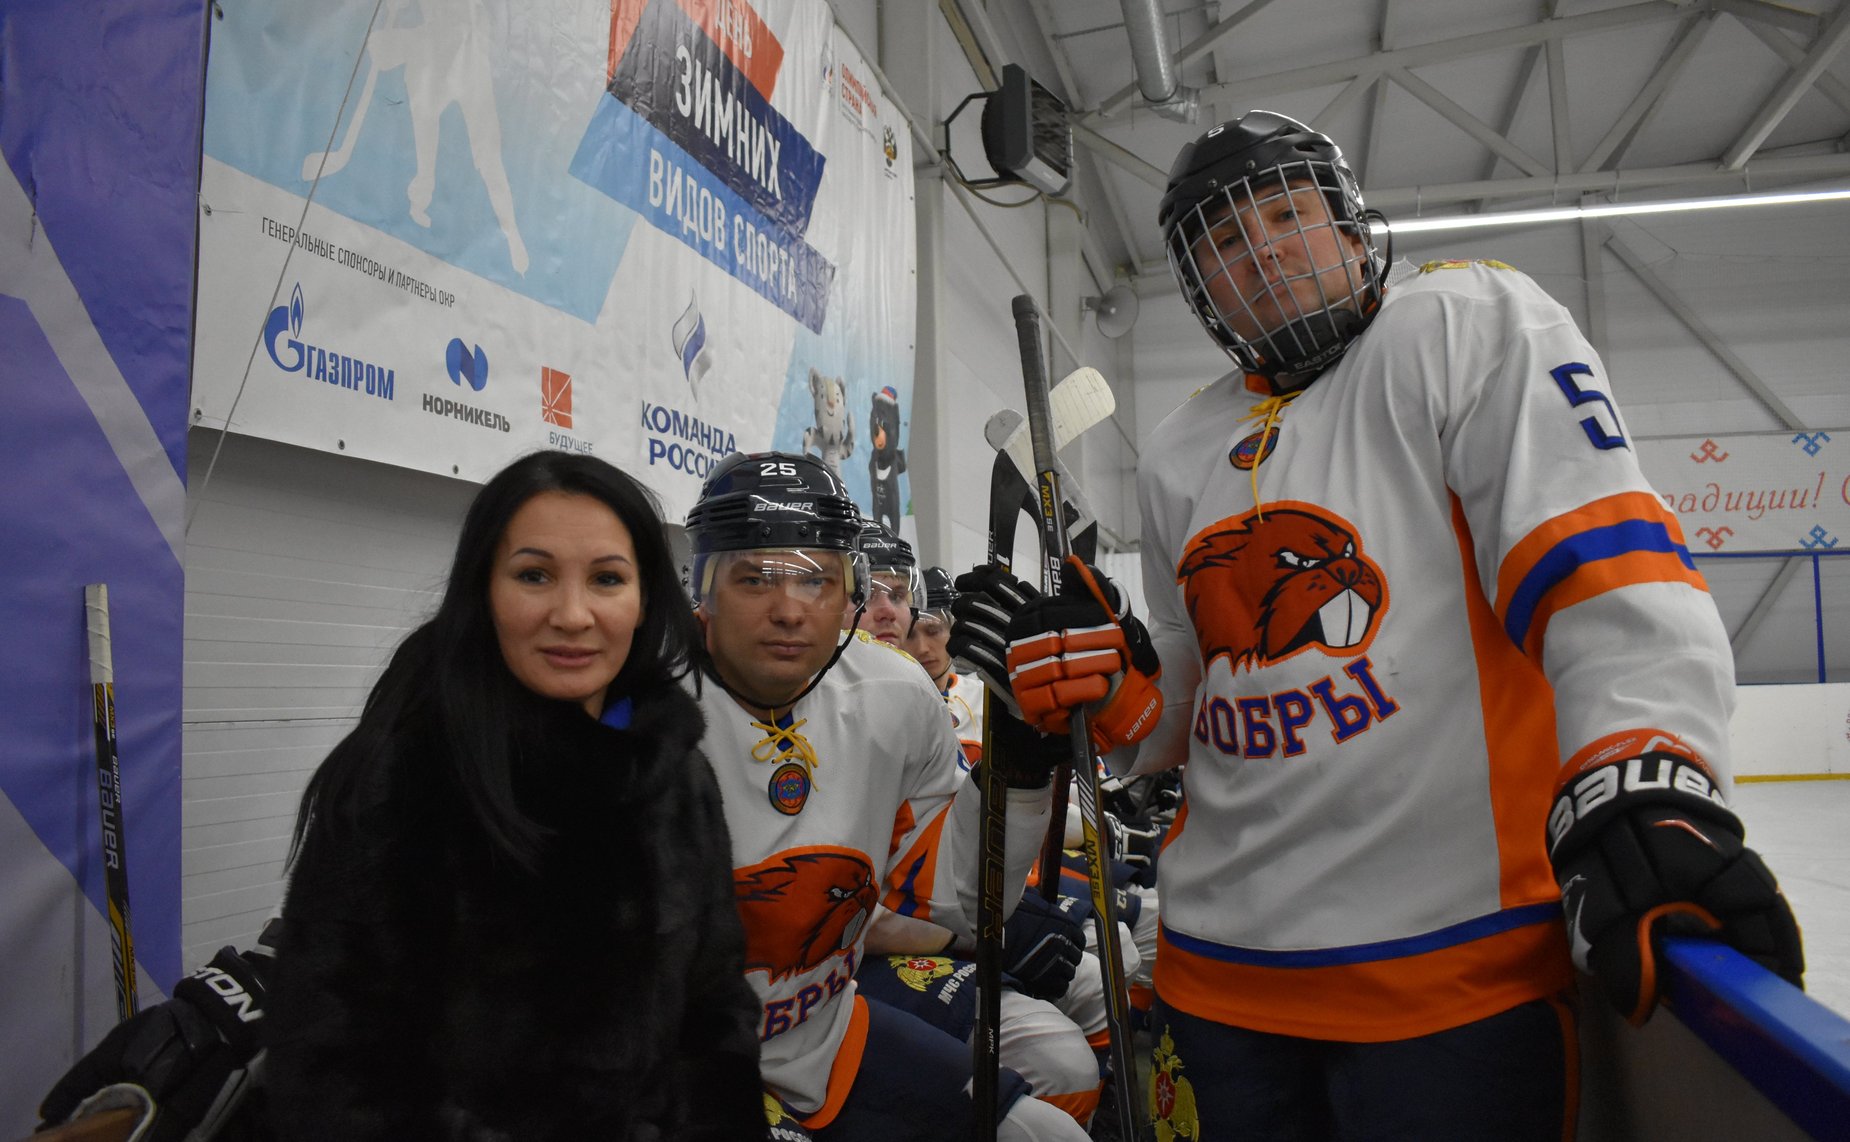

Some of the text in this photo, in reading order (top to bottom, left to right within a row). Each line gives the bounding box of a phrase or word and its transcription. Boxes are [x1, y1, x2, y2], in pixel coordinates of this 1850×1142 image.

[715, 0, 752, 58] ДЕНЬ
[675, 45, 782, 201] ЗИМНИХ
[650, 148, 798, 304] ВИДОВ СПОРТА
[261, 217, 455, 308] ГЕНЕРАЛЬНЫЕ СПОНСОРЫ И ПАРТНЕРЫ ОКР
[305, 344, 395, 401] ГАЗПРОМ
[422, 393, 511, 433] НОРНИКЕЛЬ
[641, 400, 737, 457] КОМАНДА
[1549, 362, 1631, 452] 5
[549, 431, 593, 455] БУДУЩЕЕ
[648, 437, 720, 481] РОССИ
[760, 462, 797, 476] 25
[1041, 485, 1053, 517] MX3
[938, 977, 961, 1005] МЧС
